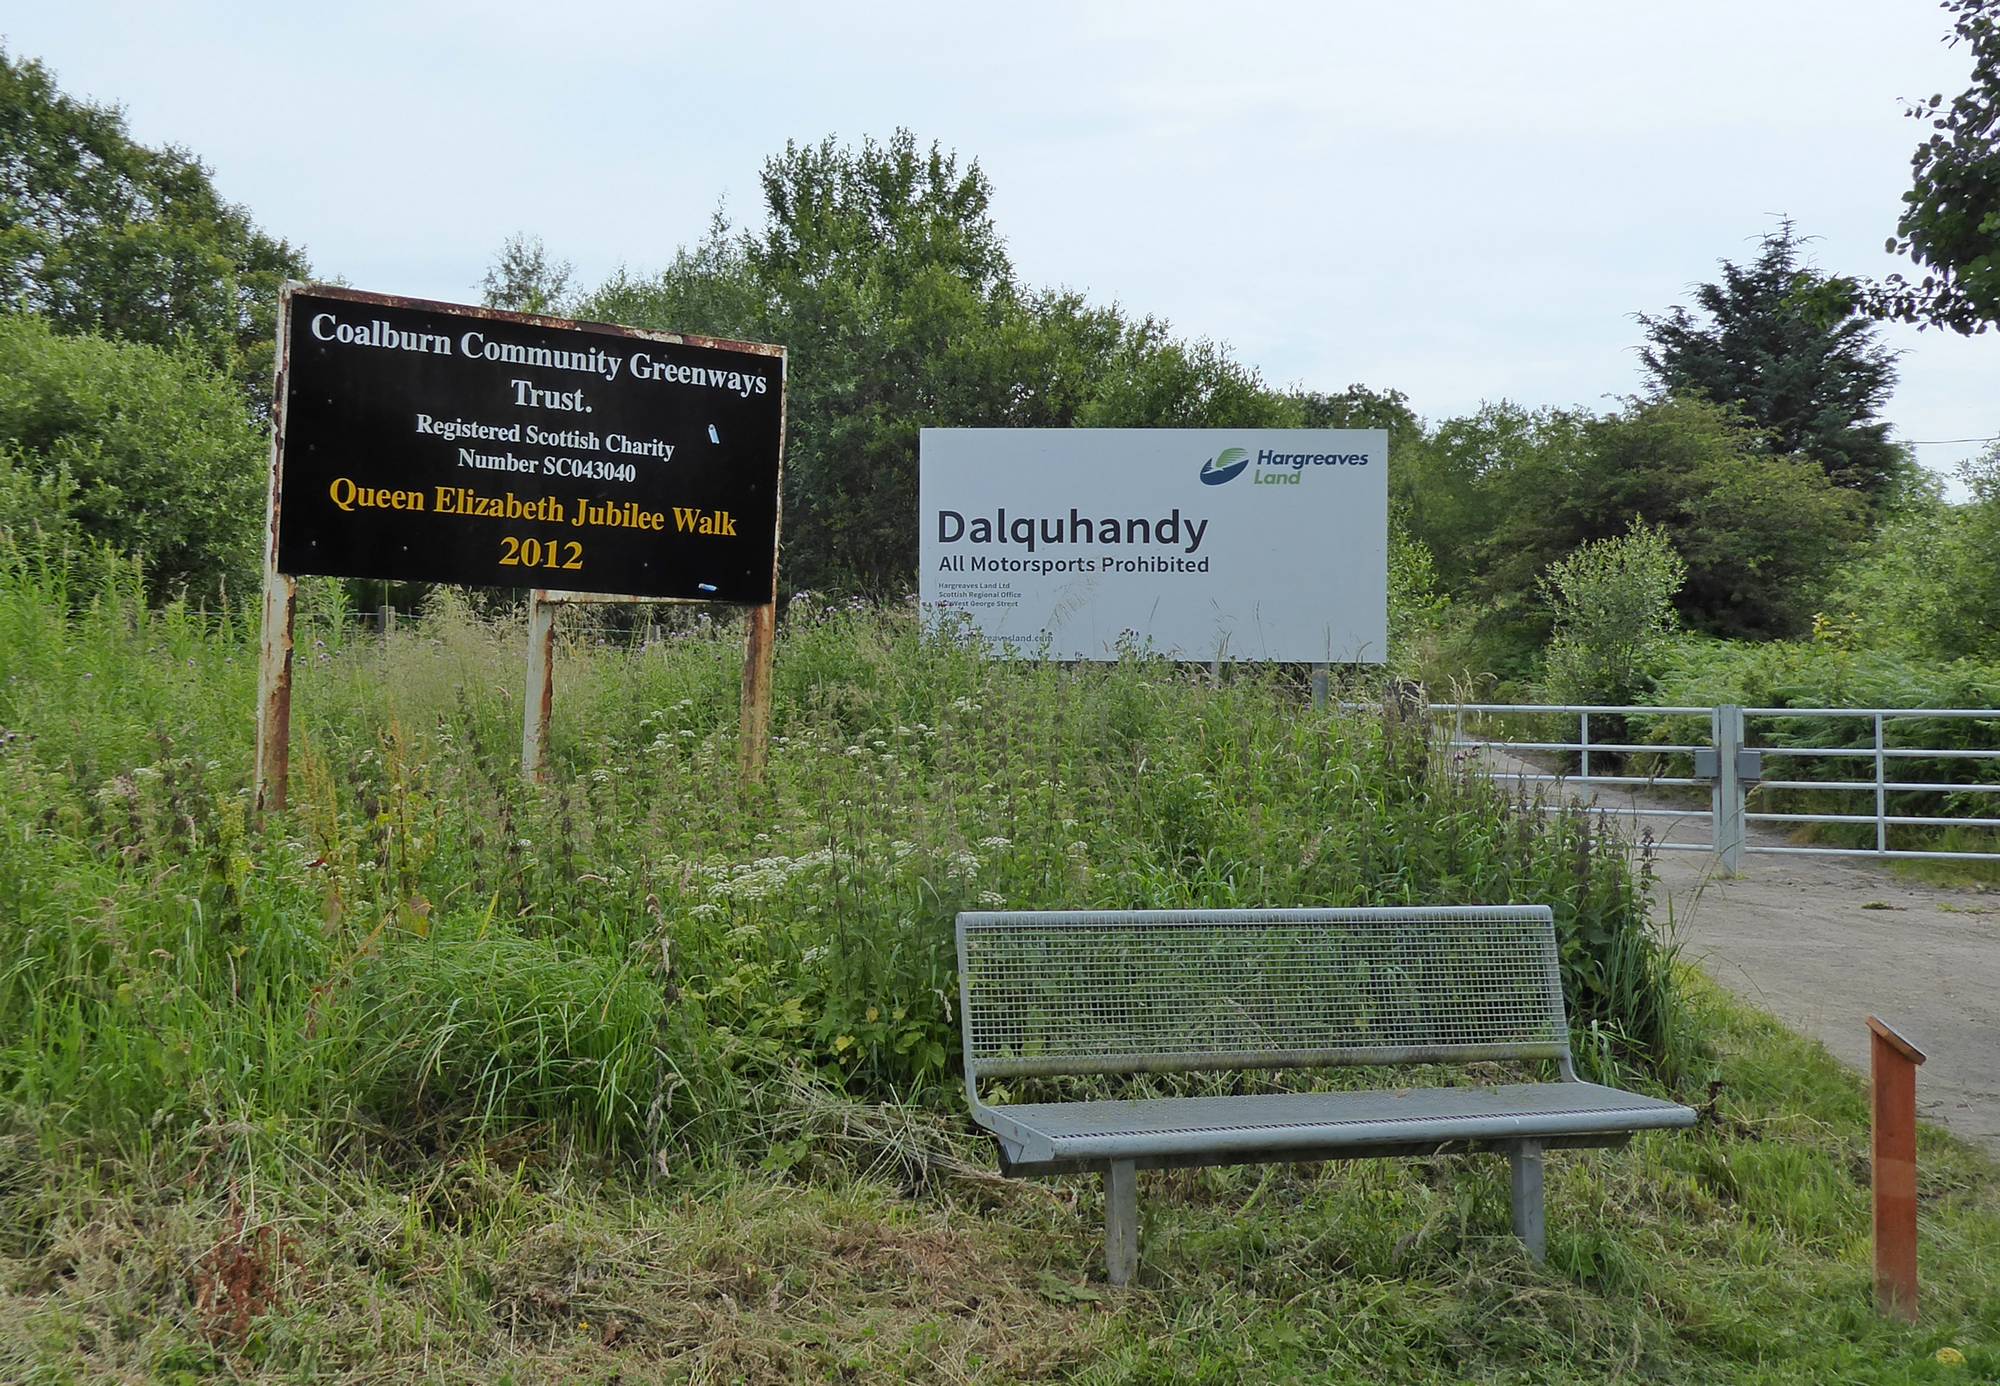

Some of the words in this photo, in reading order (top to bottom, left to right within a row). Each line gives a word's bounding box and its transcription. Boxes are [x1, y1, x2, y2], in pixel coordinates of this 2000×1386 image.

[311, 313, 452, 356] Coalburn
[461, 331, 623, 381] Community
[629, 350, 768, 398] Greenways
[511, 379, 593, 413] Trust.
[416, 414, 521, 442] Registered
[526, 426, 600, 451] Scottish
[606, 434, 675, 462] Charity
[458, 448, 539, 474] Number
[543, 457, 636, 483] SC043040
[1257, 449, 1369, 469] Hargreaves
[1254, 469, 1301, 485] Land
[329, 477, 425, 512] Queen
[434, 486, 564, 522] Elizabeth
[572, 501, 665, 531] Jubilee
[672, 507, 737, 536] Walk
[938, 508, 1209, 554] Dalquhandy
[498, 536, 583, 570] 2012
[939, 555, 965, 572] All
[971, 556, 1096, 576] Motorsports
[1102, 555, 1209, 573] Prohibited
[938, 582, 979, 590] Hargreaves
[969, 591, 1000, 599] Regional
[970, 600, 995, 608] George
